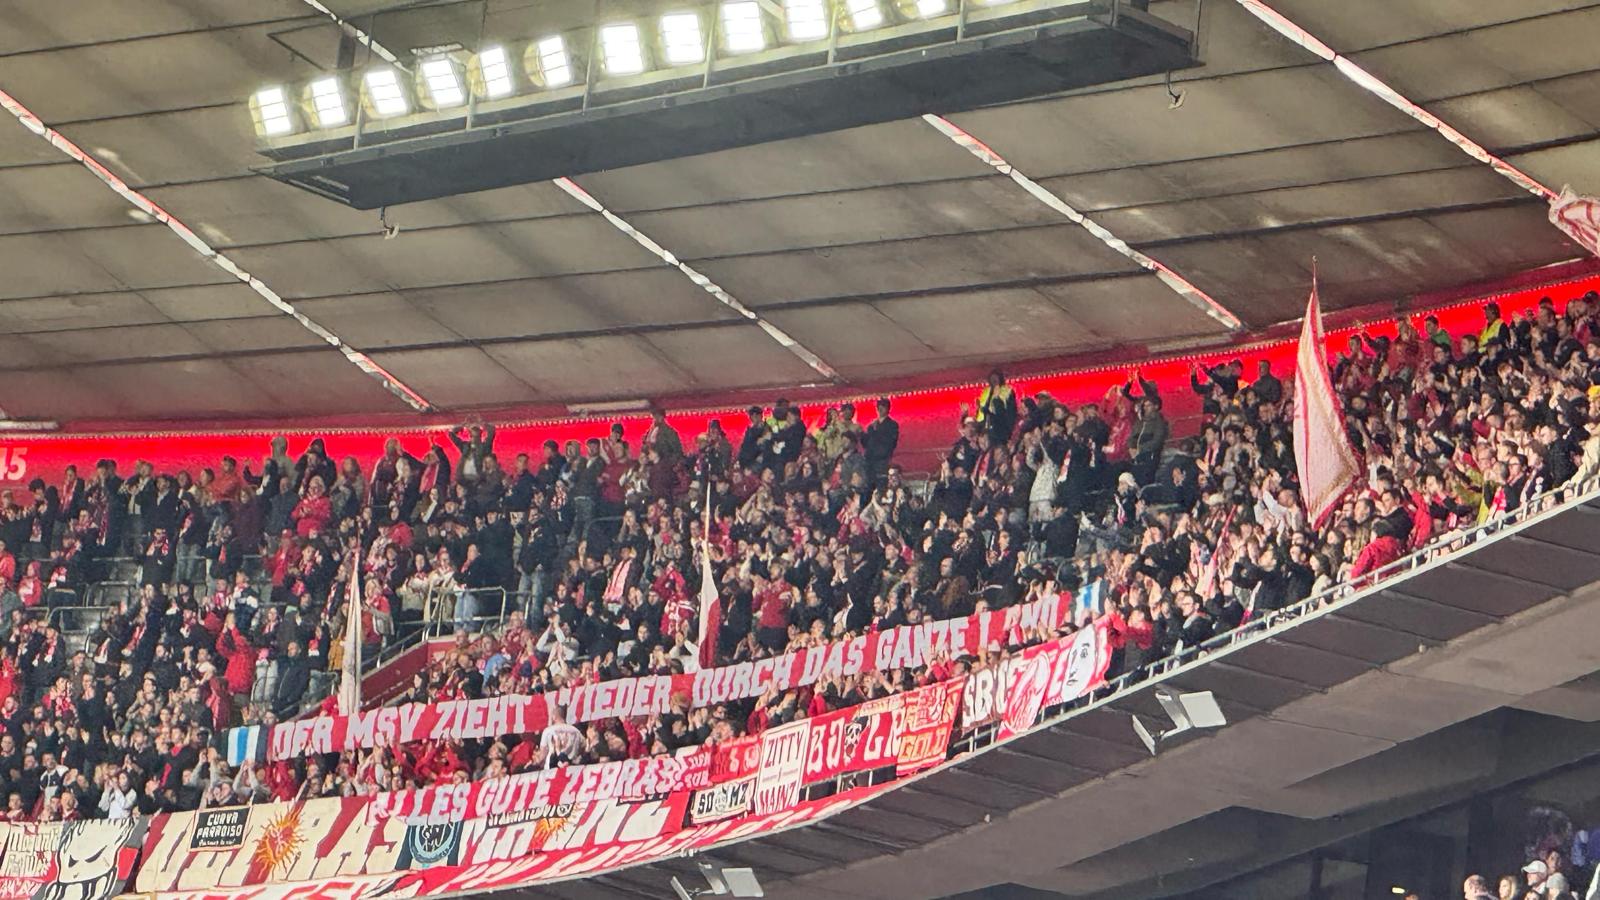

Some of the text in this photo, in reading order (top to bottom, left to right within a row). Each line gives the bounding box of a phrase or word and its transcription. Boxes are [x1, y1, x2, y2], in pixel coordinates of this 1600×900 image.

[273, 716, 334, 761] DER
[344, 702, 425, 750] MSV
[430, 693, 533, 739] ZIEHT
[545, 675, 672, 725] WIEDER
[692, 652, 797, 708] DURCH
[798, 635, 867, 686] DAS
[876, 616, 970, 670] GANZE
[764, 729, 804, 768] ZITTY
[366, 782, 471, 827] ALLES
[475, 767, 559, 816] GUTE
[759, 780, 798, 814] MAINZ
[206, 811, 239, 826] CURVA
